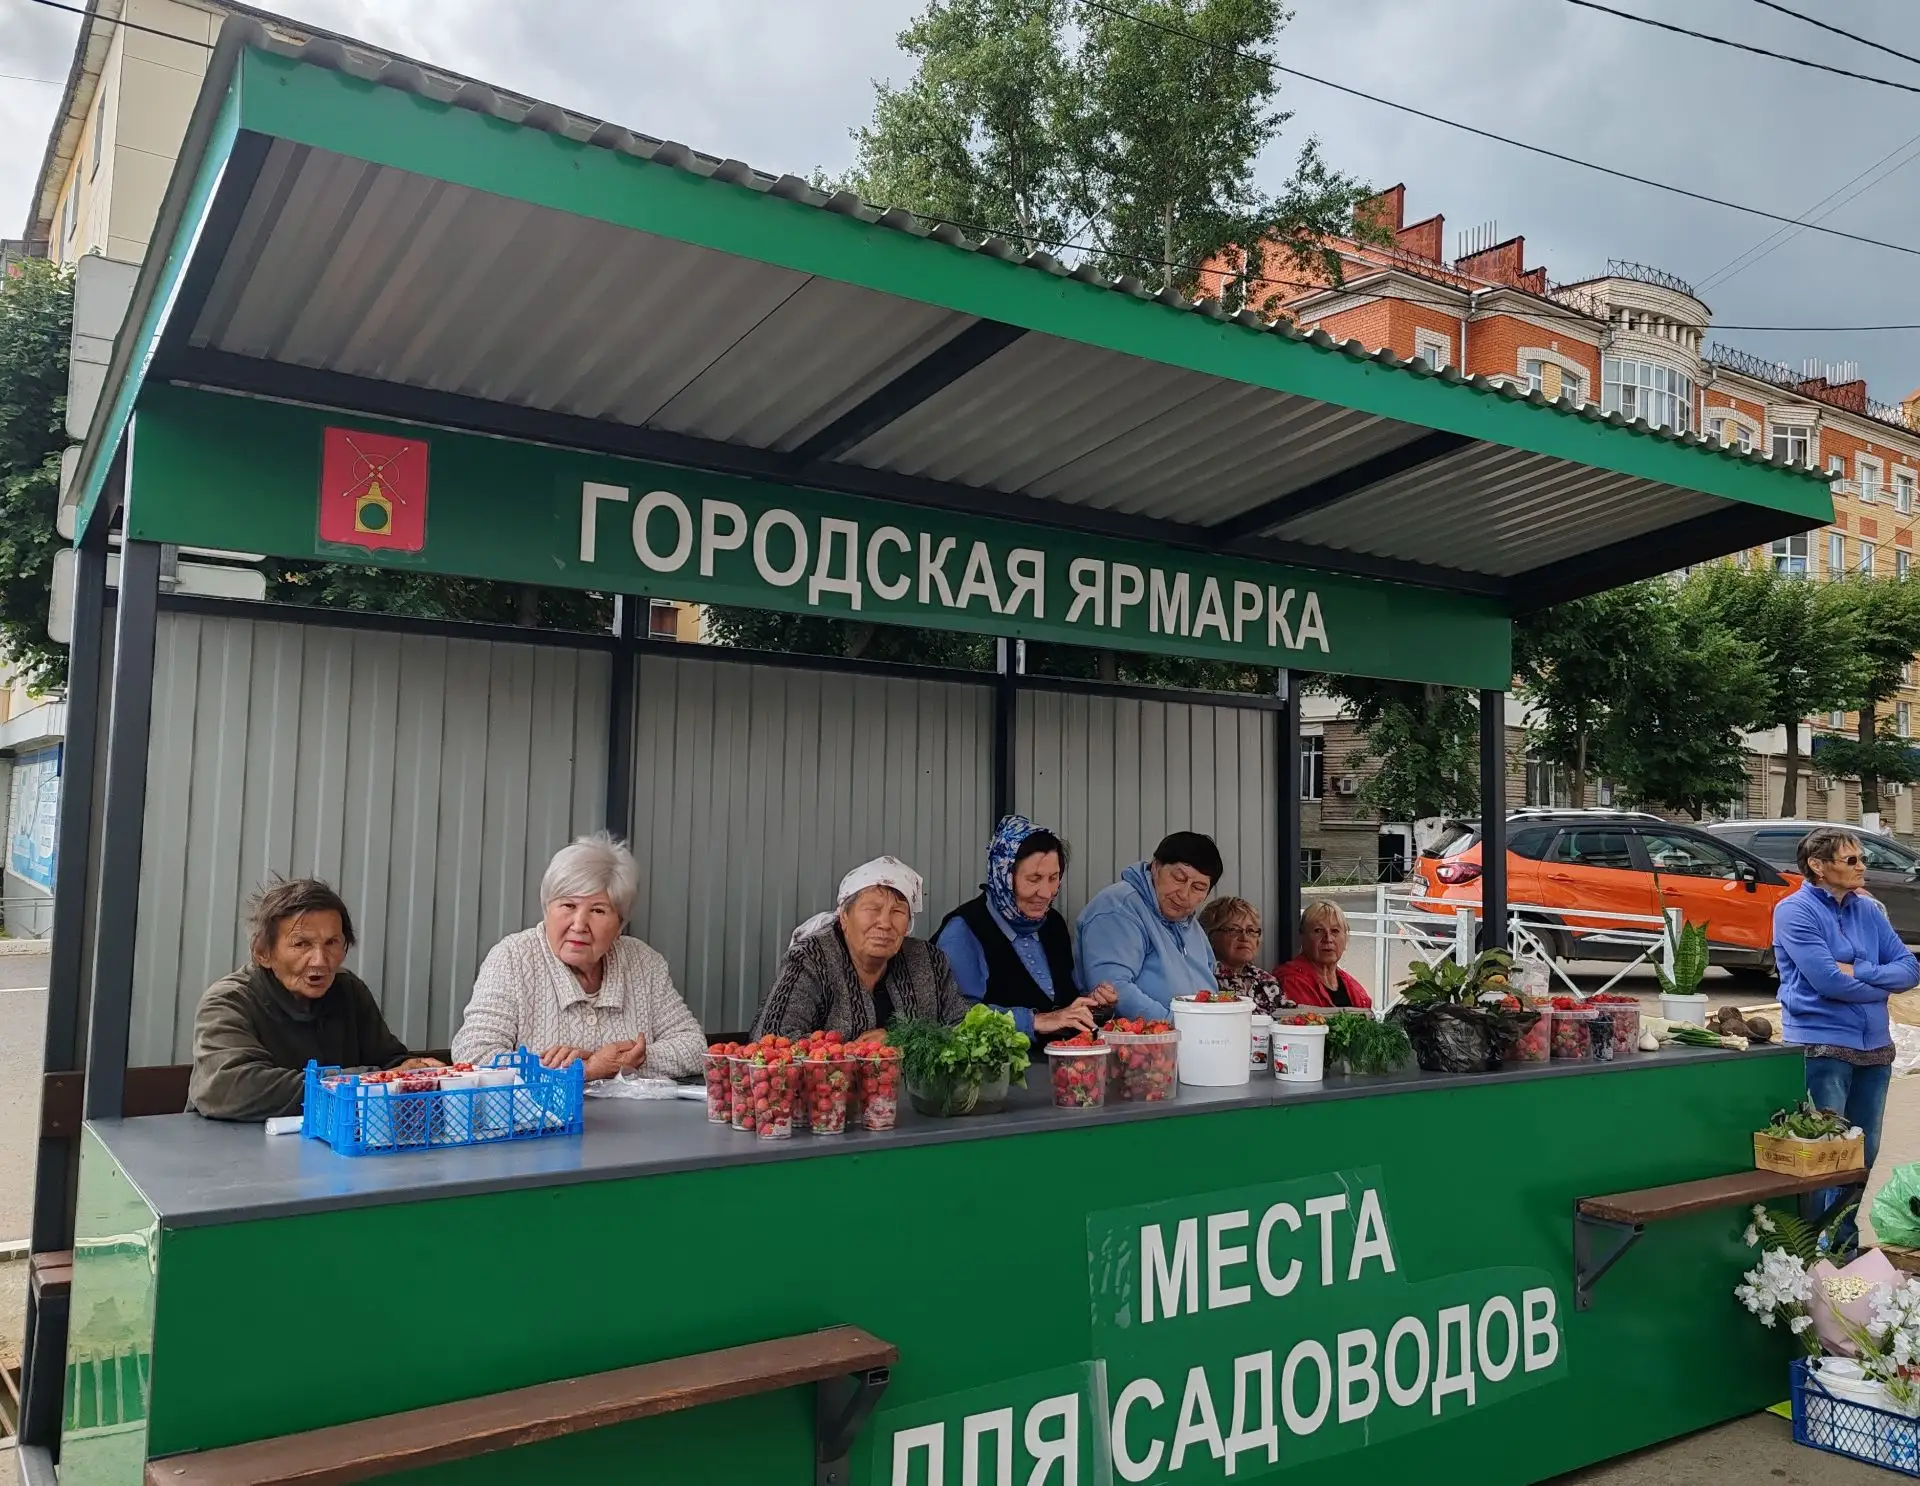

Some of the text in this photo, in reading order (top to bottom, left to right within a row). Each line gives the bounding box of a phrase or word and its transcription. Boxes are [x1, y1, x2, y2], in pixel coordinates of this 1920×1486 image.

[579, 481, 1331, 654] ГОРОДСКАЯ ЯРМАРКА
[1140, 1187, 1397, 1325] МЕСТА
[1110, 1286, 1560, 1483] САДОВОДОВ
